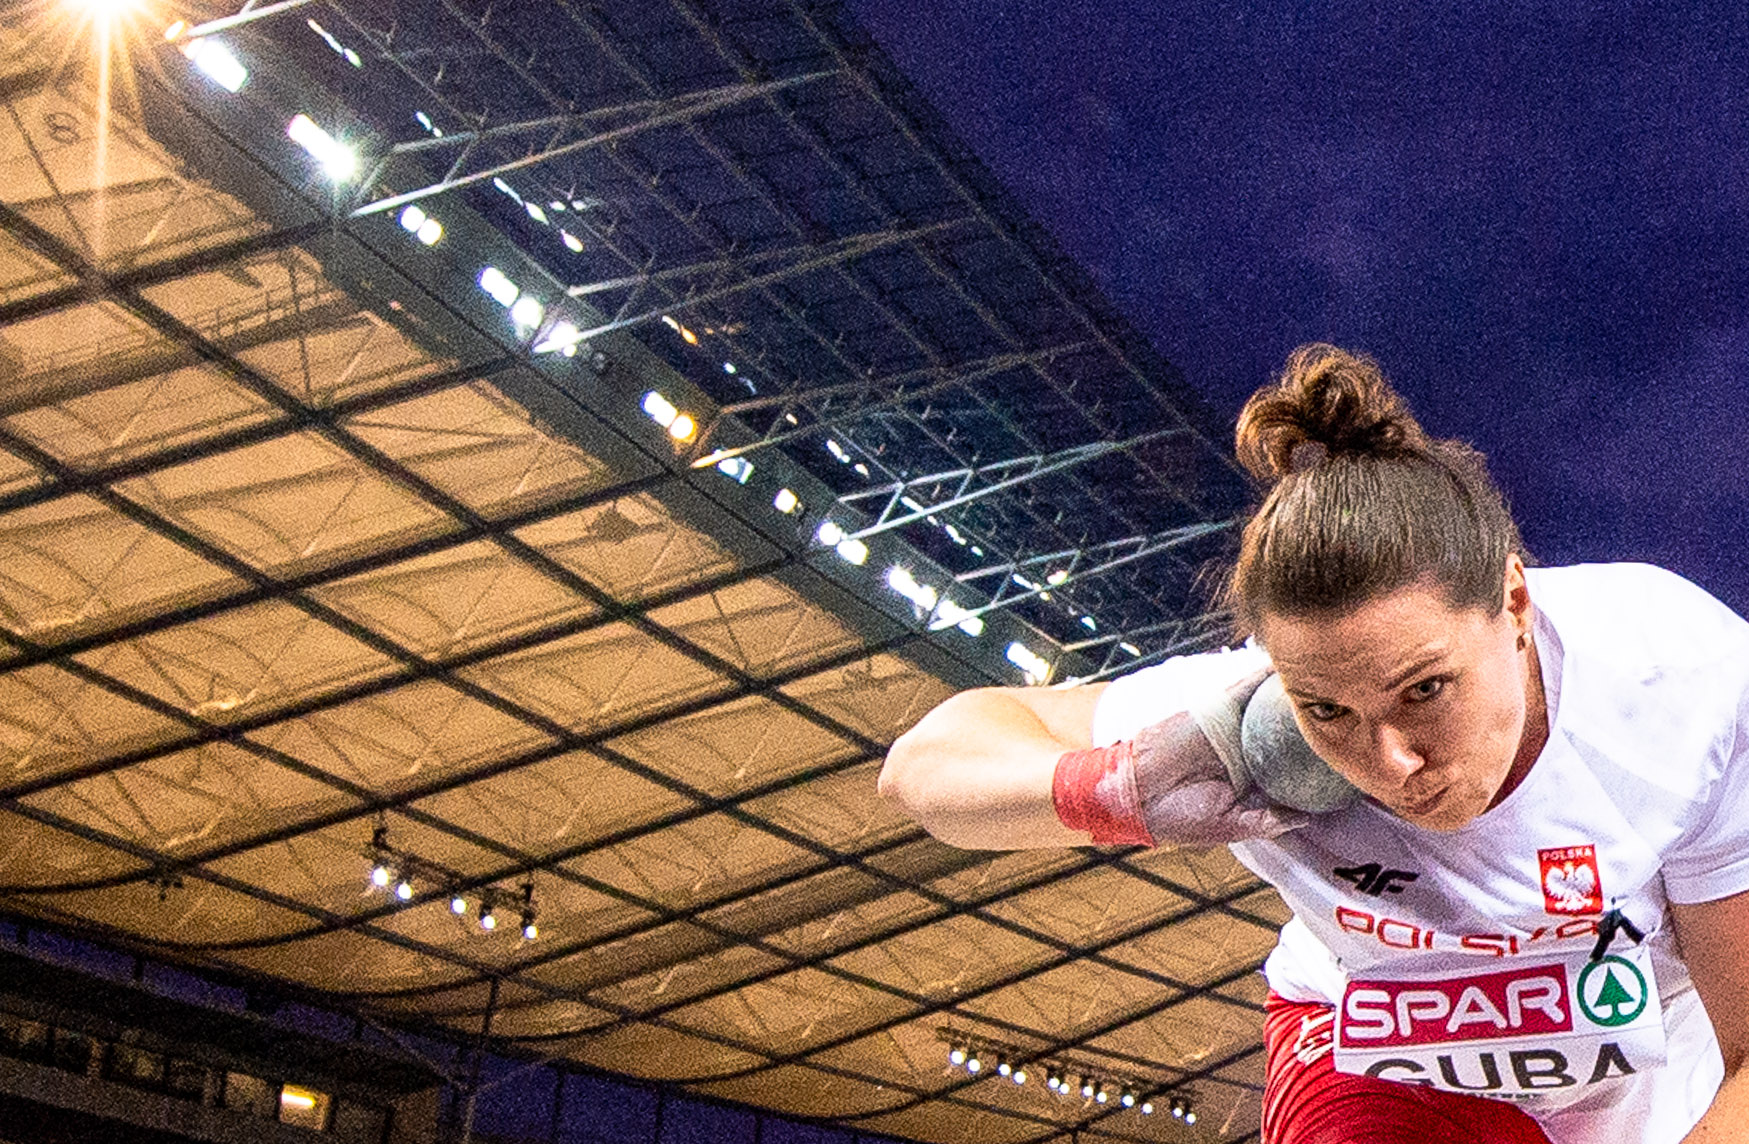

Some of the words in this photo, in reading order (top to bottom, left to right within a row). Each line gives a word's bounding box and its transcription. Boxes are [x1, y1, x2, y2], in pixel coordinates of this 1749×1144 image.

[1541, 848, 1594, 862] POLSKA
[1345, 975, 1566, 1040] SPAR
[1364, 1042, 1637, 1092] GUBA
